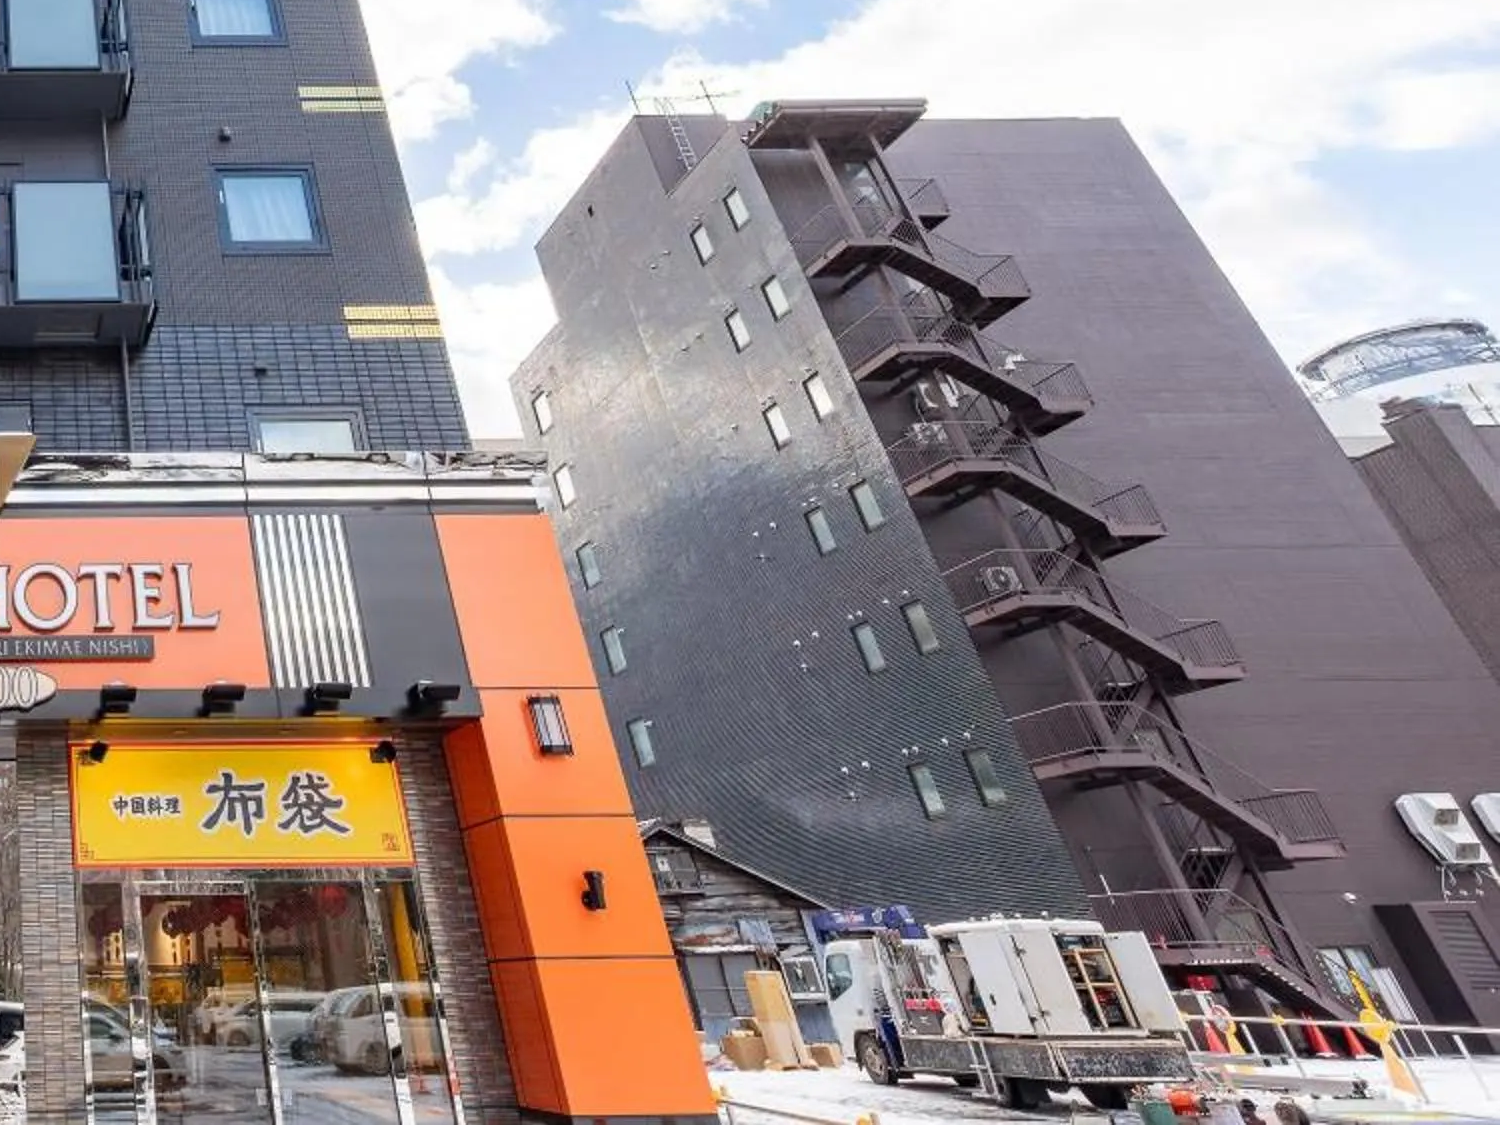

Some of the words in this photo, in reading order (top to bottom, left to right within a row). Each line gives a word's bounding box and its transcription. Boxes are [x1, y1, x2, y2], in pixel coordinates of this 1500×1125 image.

[14, 640, 83, 656] EKIMAE
[113, 795, 181, 817] 中国料理
[201, 772, 351, 836] 布袋
